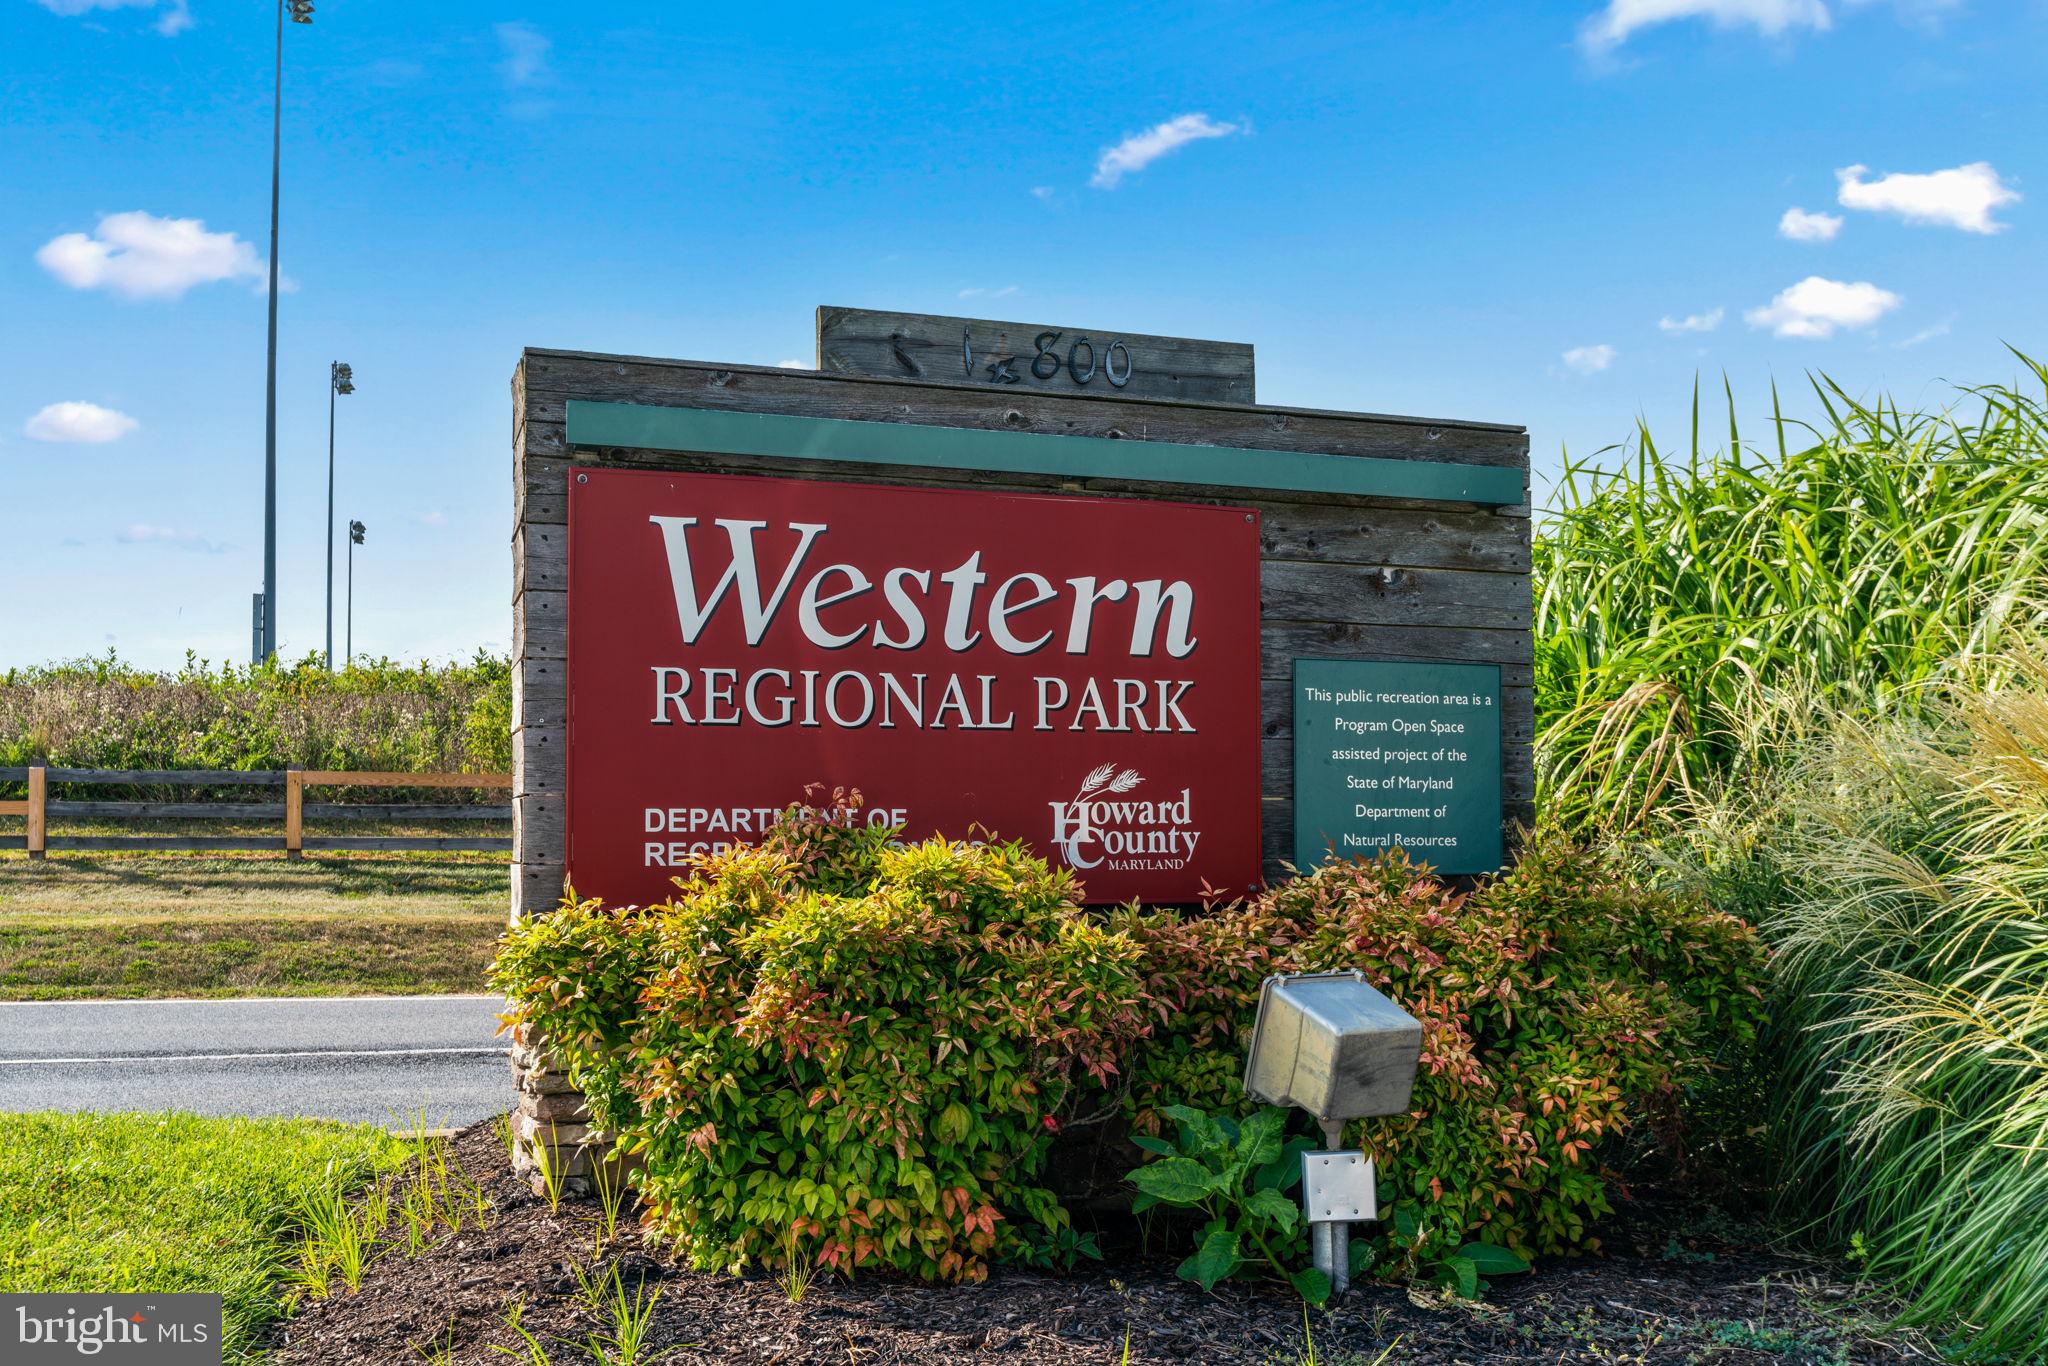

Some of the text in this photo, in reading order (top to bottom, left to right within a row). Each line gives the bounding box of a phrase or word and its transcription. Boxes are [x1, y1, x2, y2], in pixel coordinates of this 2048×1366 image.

[649, 514, 1198, 658] Western
[650, 666, 1198, 733] REGIONAL PARK
[1304, 687, 1493, 706] This public recreation area is a
[1334, 717, 1465, 736] Program Open Space
[1331, 746, 1468, 765] assisted project of the
[1346, 775, 1454, 793] State of Maryland
[867, 808, 908, 832] OF
[1048, 788, 1193, 843] Howard
[1355, 804, 1448, 821] Department of
[1068, 825, 1201, 870] County
[1343, 833, 1458, 847] Natural Resources
[1108, 858, 1185, 871] MARYLAND
